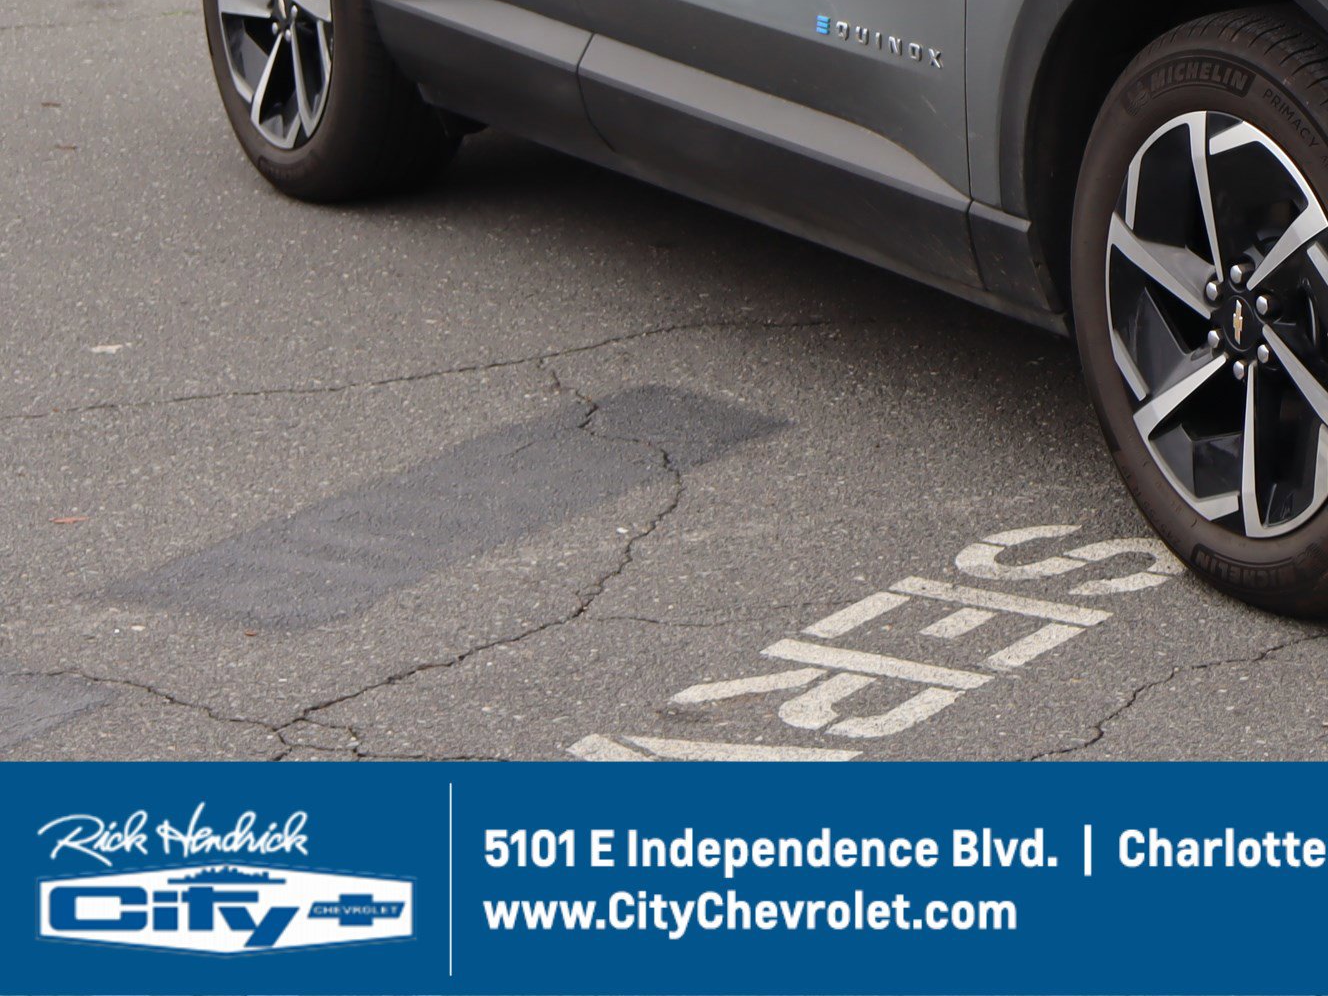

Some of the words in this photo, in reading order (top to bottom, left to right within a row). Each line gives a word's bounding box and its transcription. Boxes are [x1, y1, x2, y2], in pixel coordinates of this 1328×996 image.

[815, 14, 944, 69] EQUINOX
[1150, 60, 1250, 93] MICHELIN
[1262, 88, 1320, 149] PRIMACY
